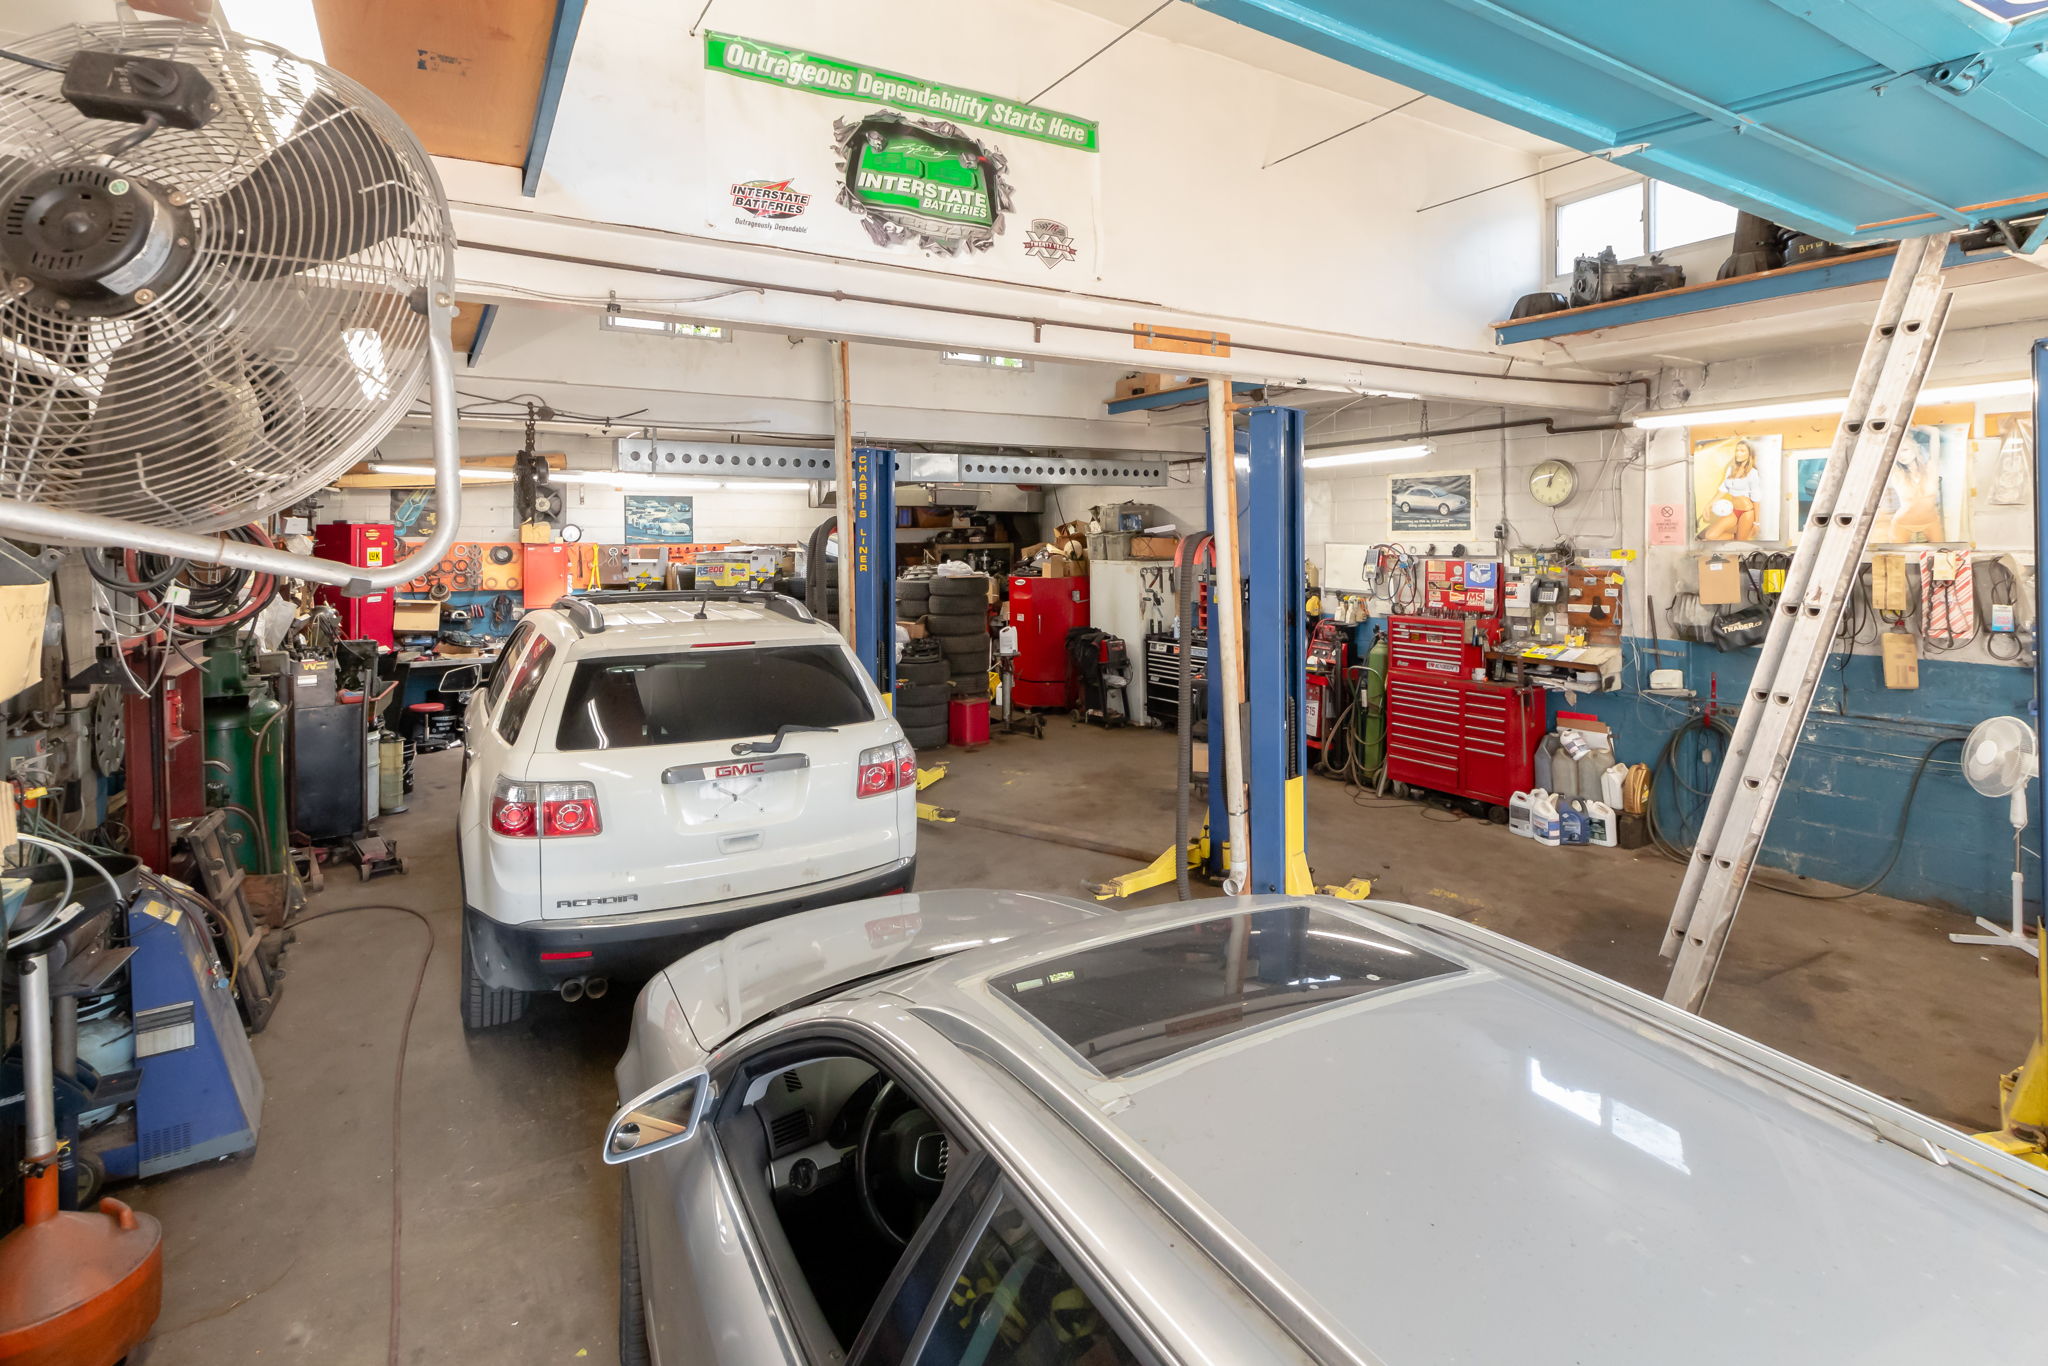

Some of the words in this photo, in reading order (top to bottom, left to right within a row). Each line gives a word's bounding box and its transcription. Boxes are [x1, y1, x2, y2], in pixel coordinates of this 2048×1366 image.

[726, 43, 853, 90] Outrageous
[858, 72, 989, 123] Dependability
[991, 103, 1044, 132] Starts
[1048, 116, 1085, 142] Here
[732, 185, 809, 205] INTERSTATE
[857, 171, 987, 208] INTERSTATE
[735, 196, 803, 214] BATTERIES
[922, 198, 987, 218] BATTERIES
[735, 217, 773, 231] Outrageously
[774, 223, 807, 234] Dependable
[858, 455, 868, 519] CHASSIS
[858, 528, 868, 572] LINER
[715, 762, 765, 778] GMC
[556, 893, 639, 908] ACADIA
